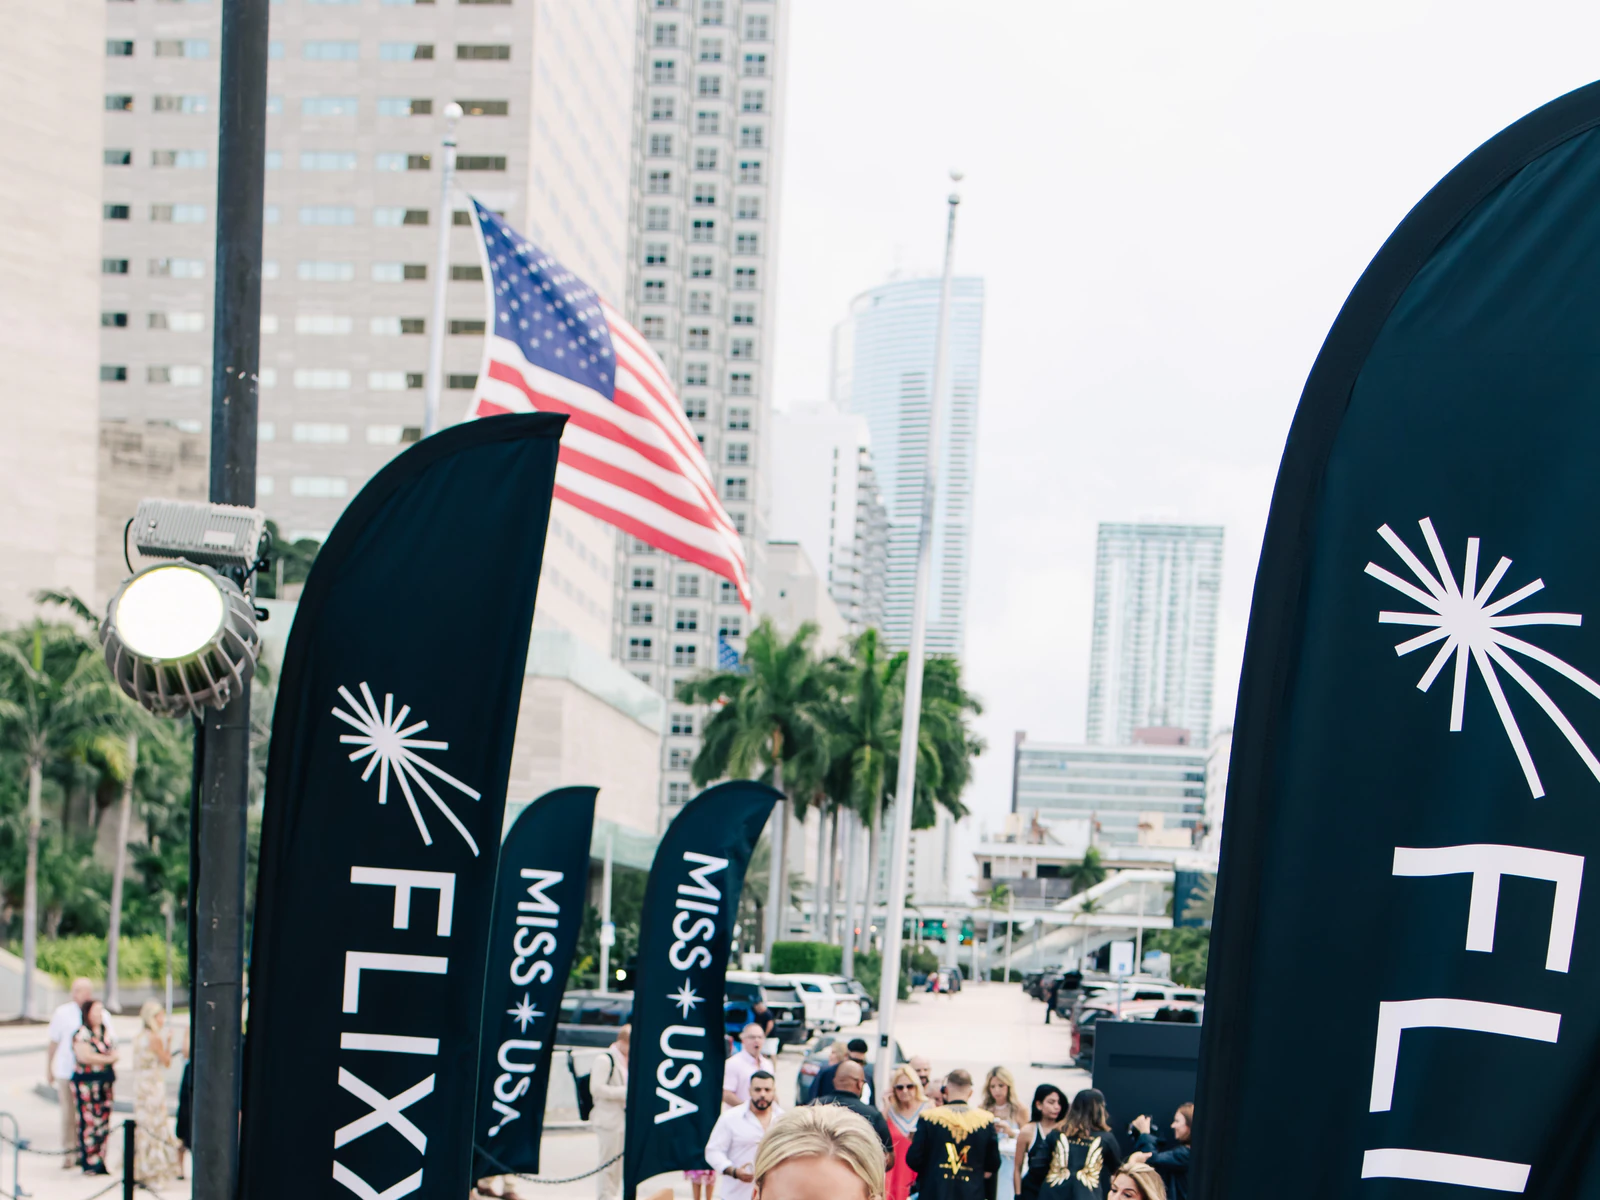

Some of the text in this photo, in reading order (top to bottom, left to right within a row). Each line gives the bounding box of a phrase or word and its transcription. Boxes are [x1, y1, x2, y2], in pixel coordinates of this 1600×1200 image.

[509, 868, 564, 986] MISS
[654, 851, 730, 1125] MISS USA
